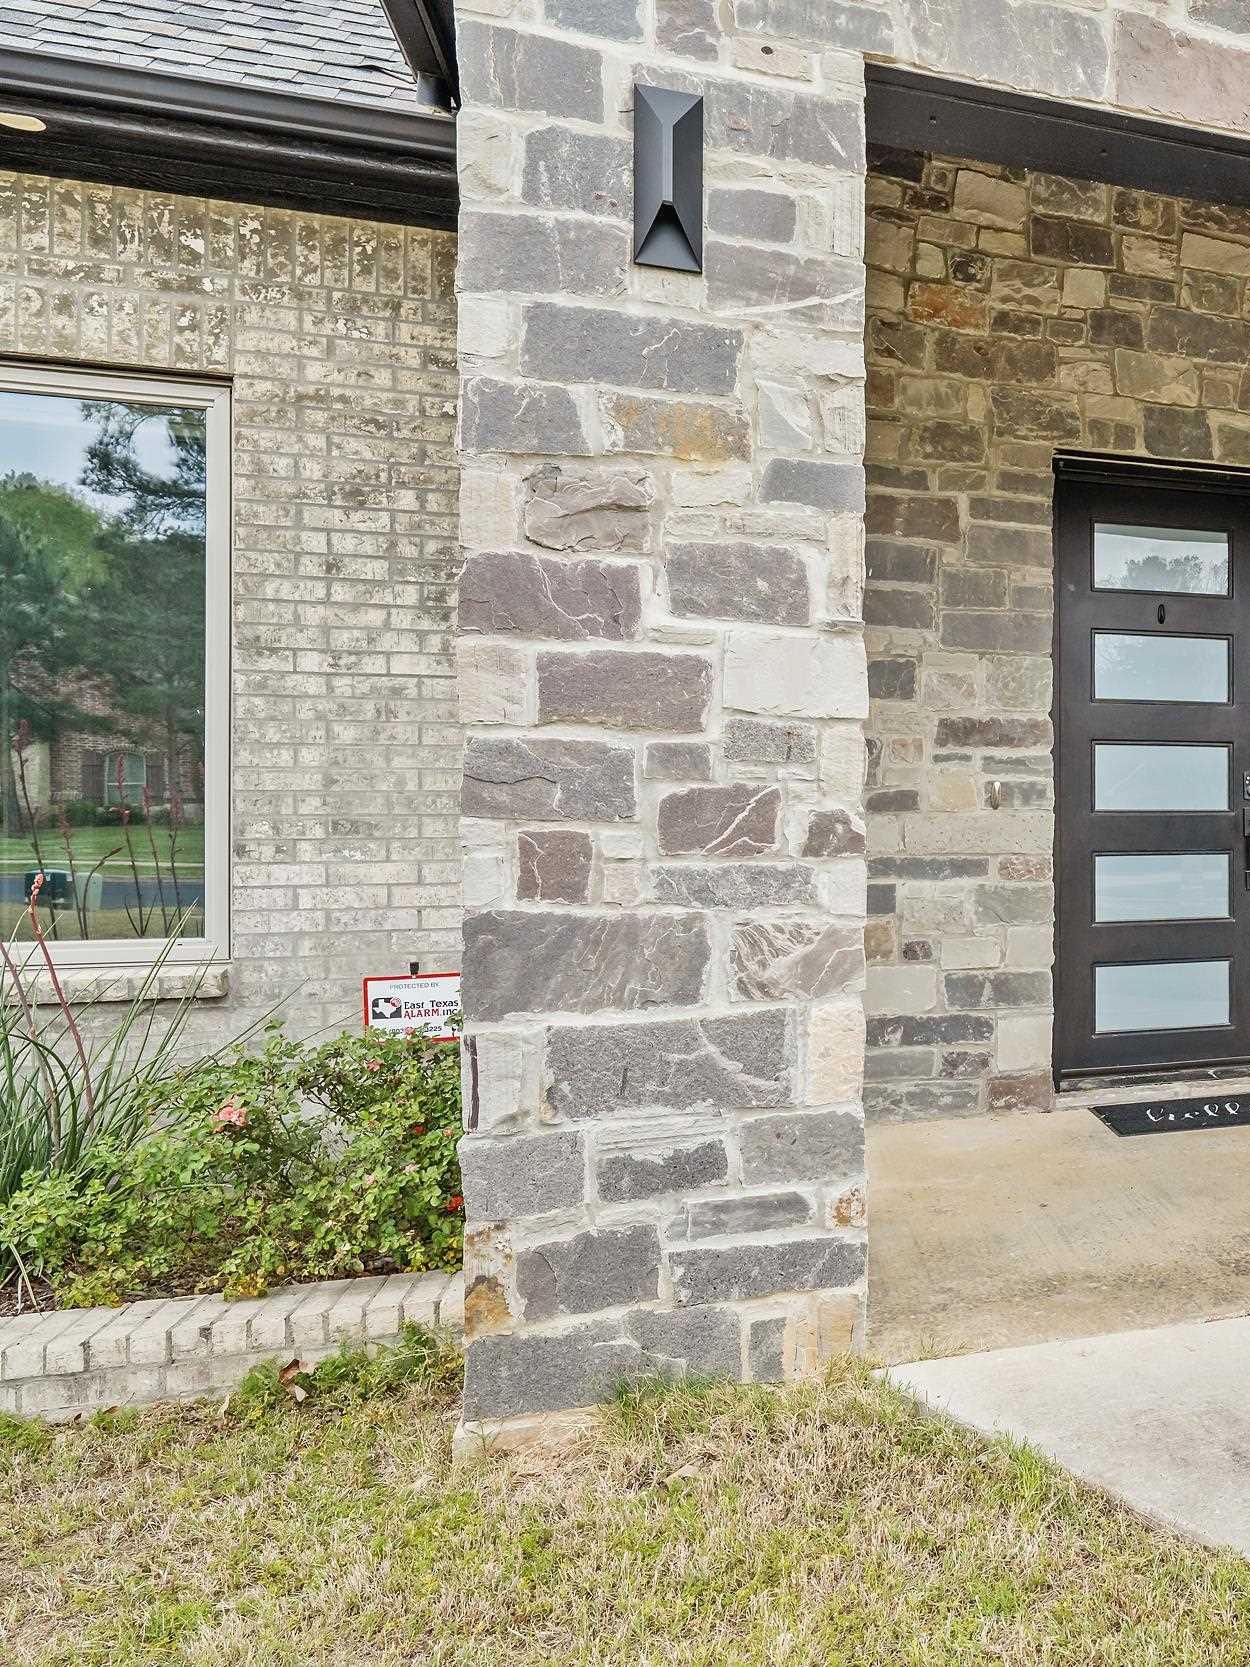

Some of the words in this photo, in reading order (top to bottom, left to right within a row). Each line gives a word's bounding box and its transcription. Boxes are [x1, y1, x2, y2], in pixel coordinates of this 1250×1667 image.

[389, 982, 429, 990] PROTECTED
[404, 1001, 424, 1010] East
[429, 1000, 459, 1008] Texas
